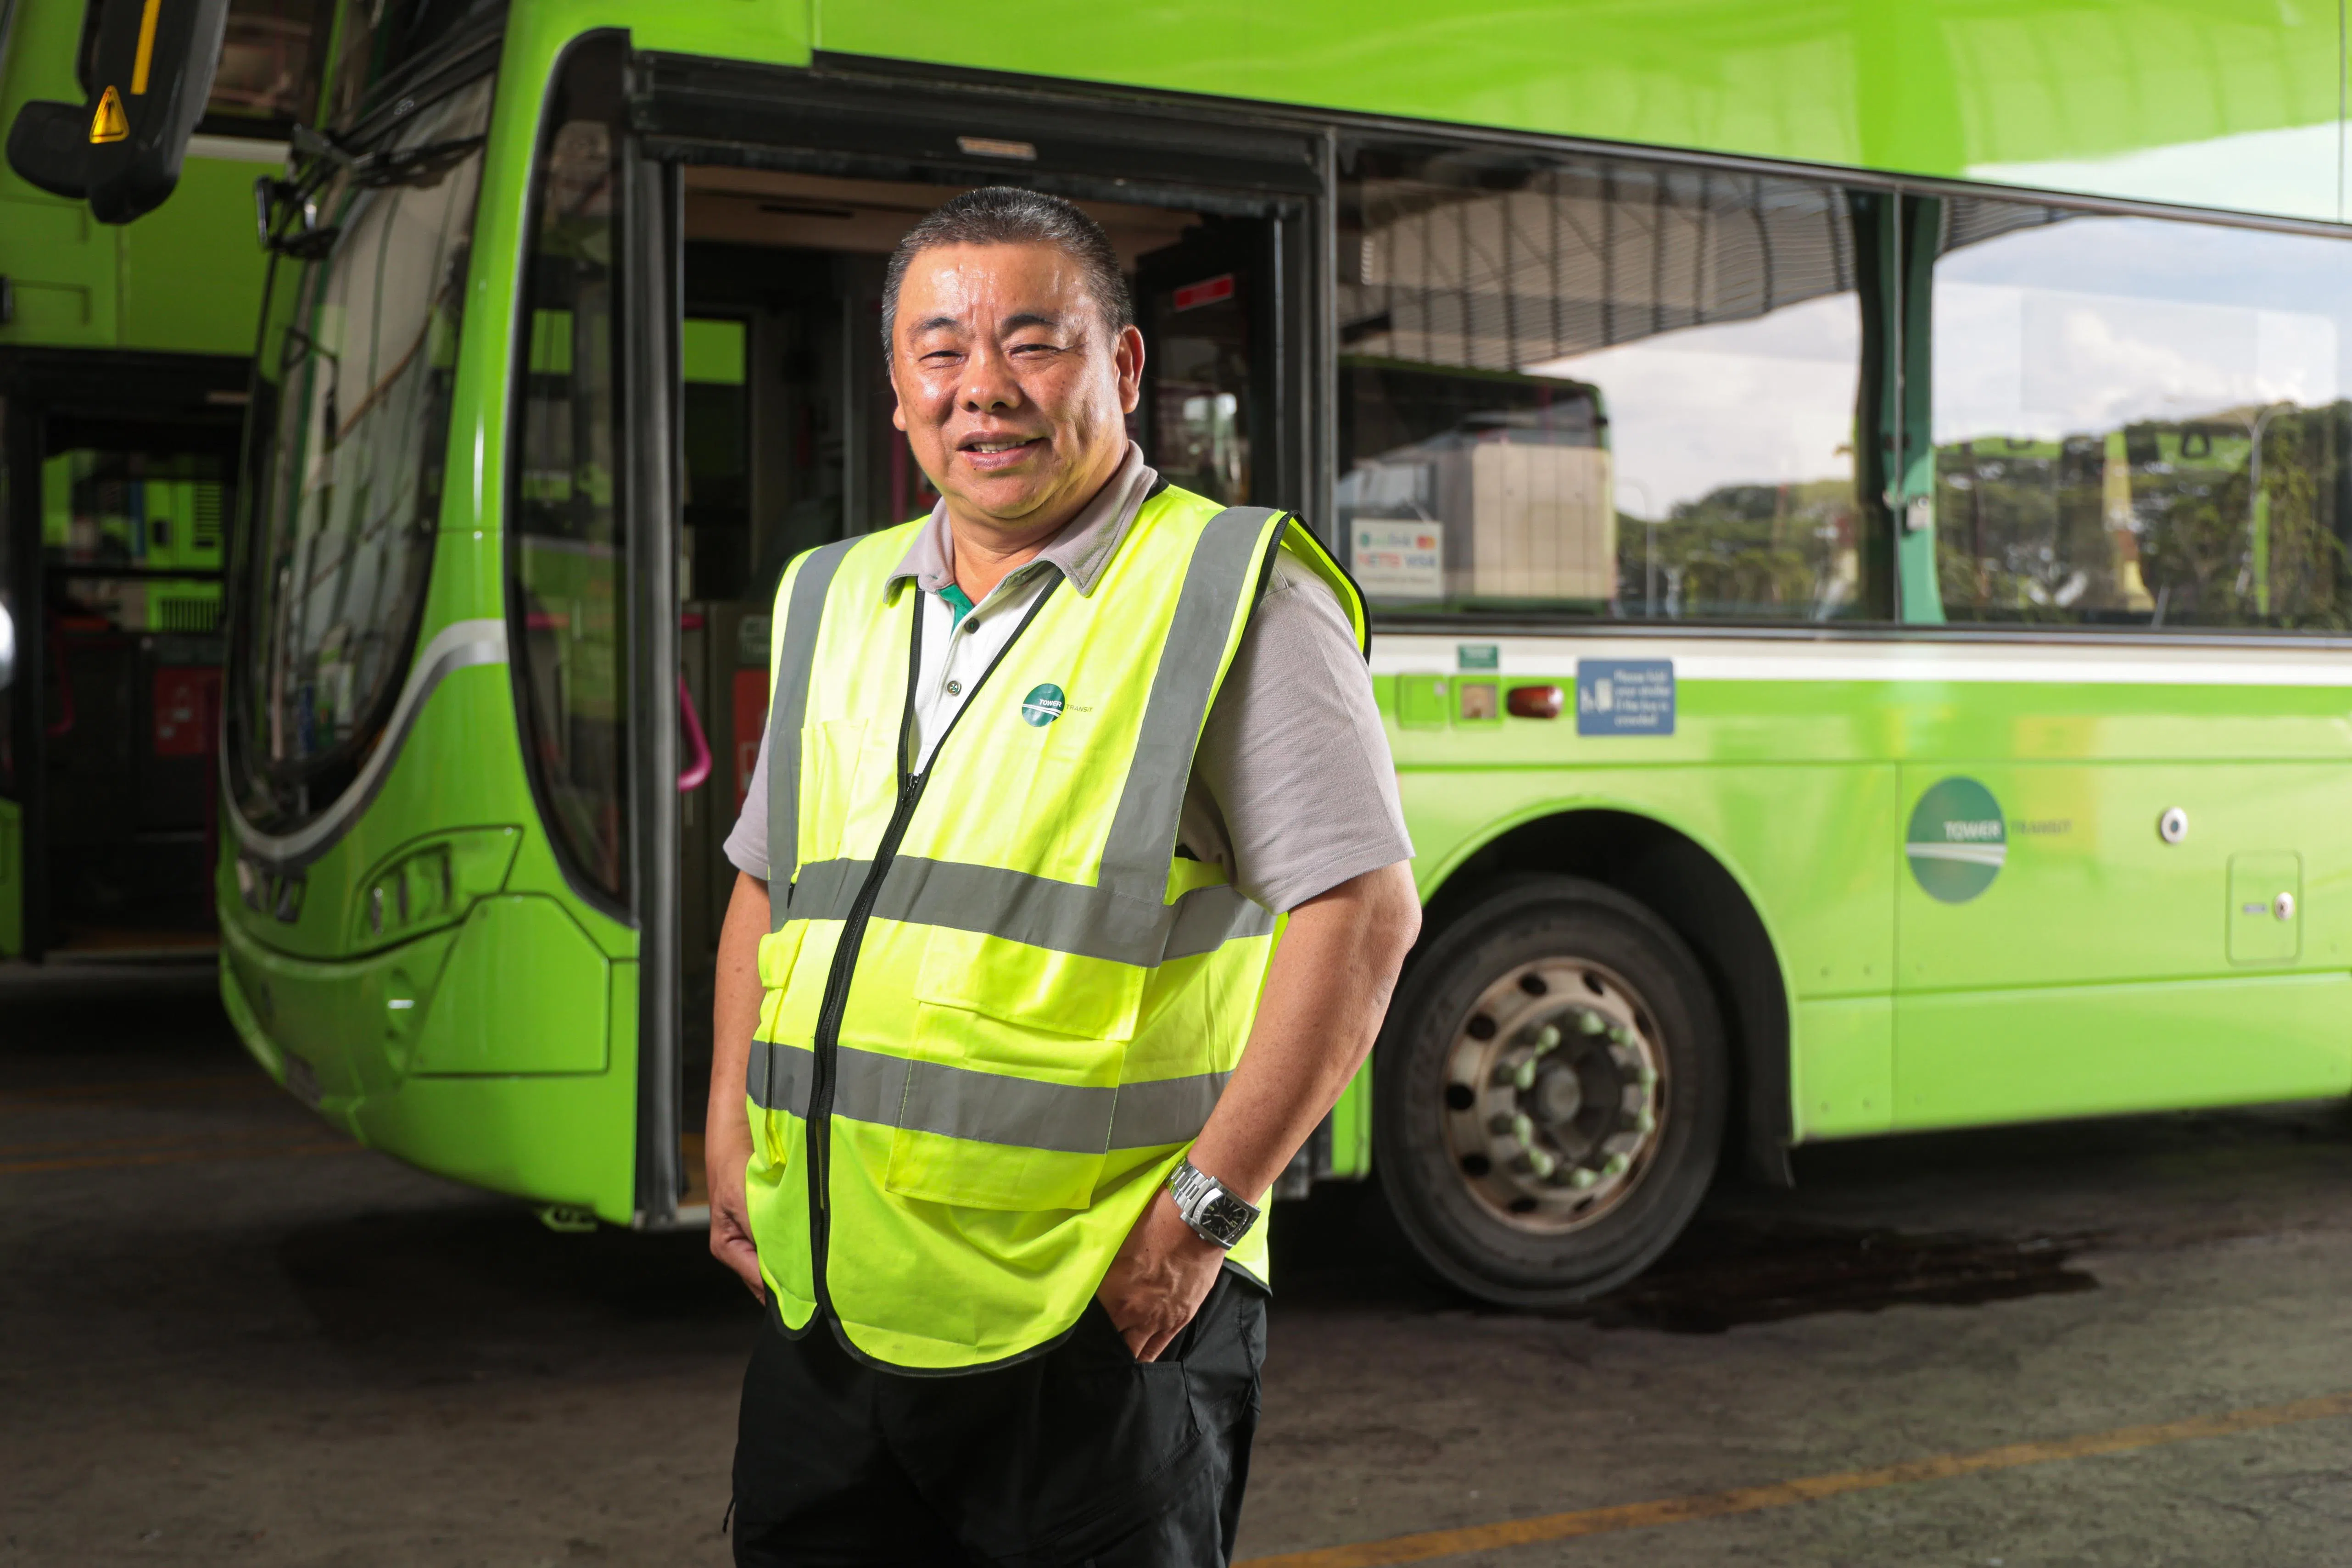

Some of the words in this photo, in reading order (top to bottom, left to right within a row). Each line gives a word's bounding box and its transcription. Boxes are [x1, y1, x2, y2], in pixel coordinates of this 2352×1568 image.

[1039, 699, 1062, 708] TOWER
[1066, 704, 1093, 712] TRANSIT
[1944, 820, 2002, 841] TOWER
